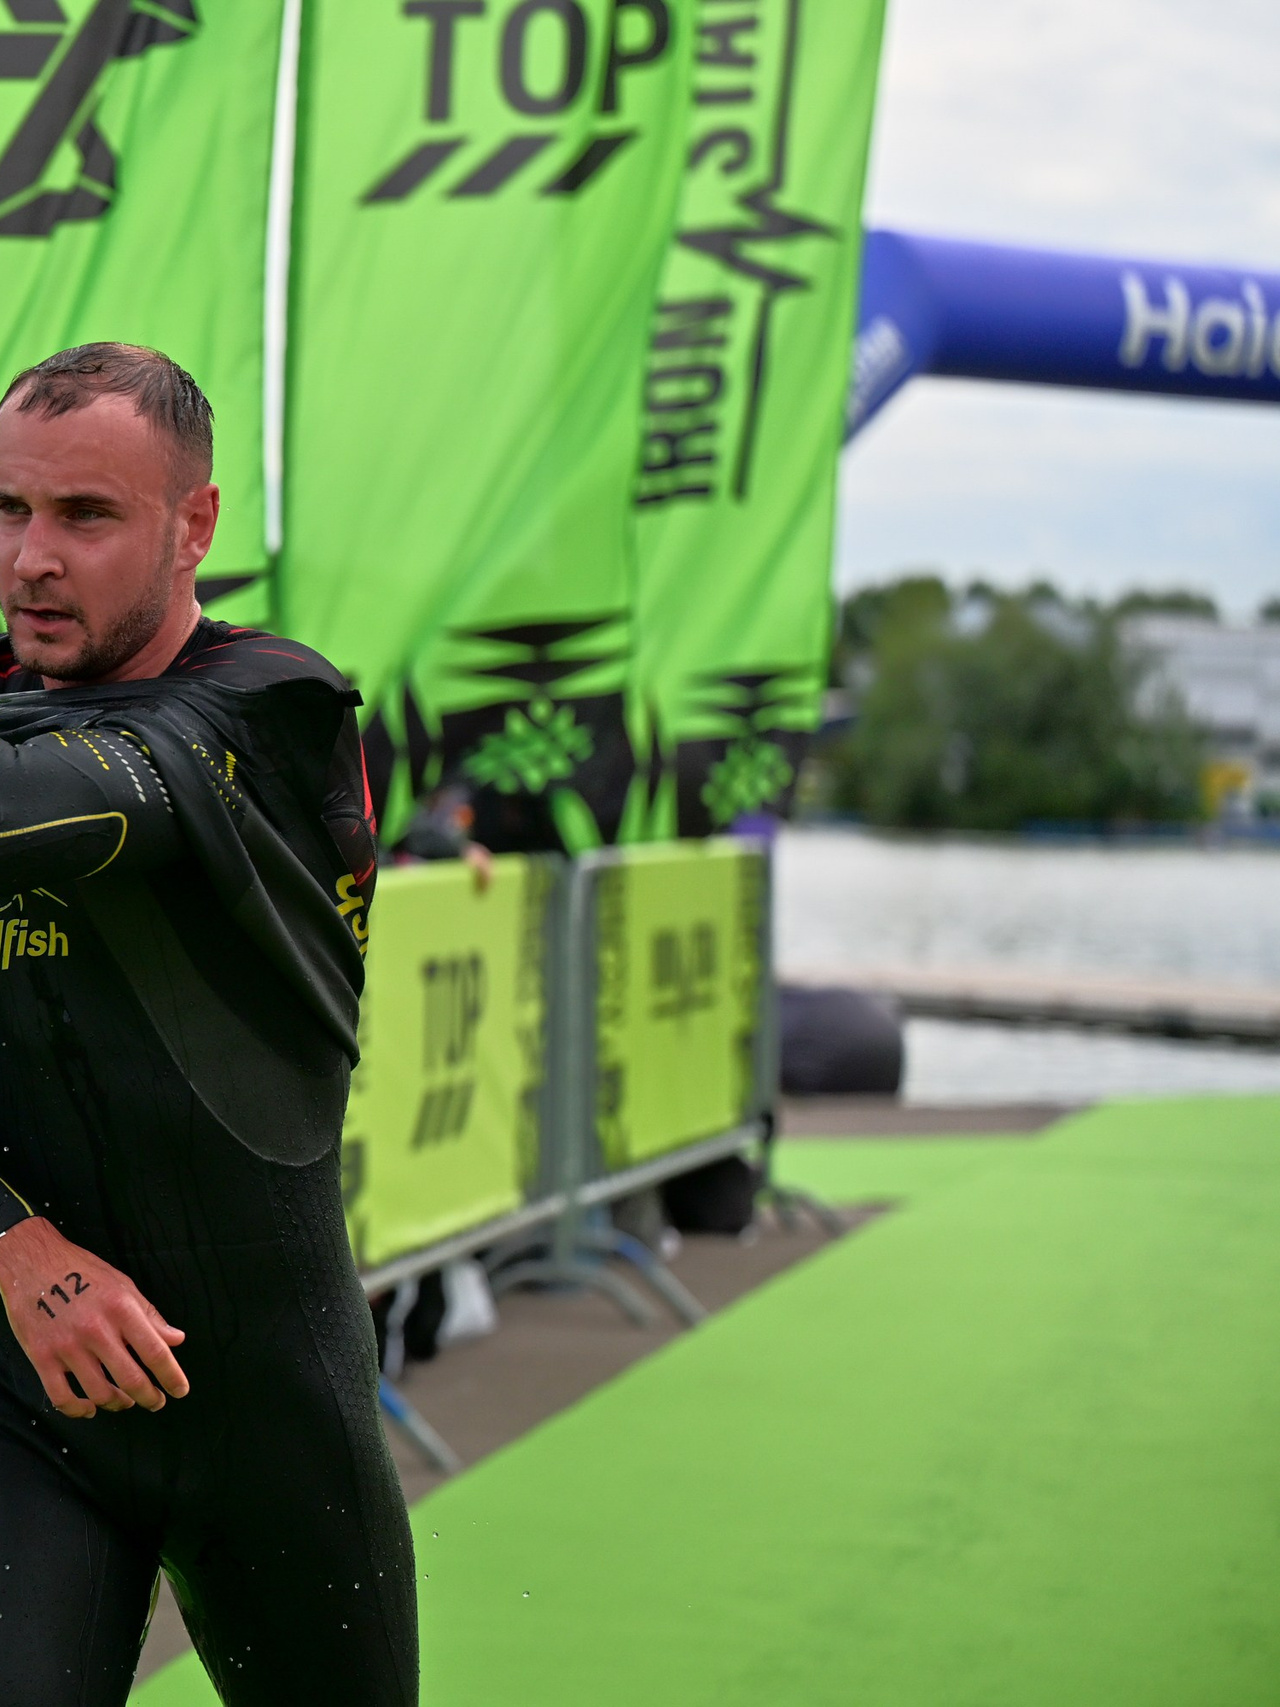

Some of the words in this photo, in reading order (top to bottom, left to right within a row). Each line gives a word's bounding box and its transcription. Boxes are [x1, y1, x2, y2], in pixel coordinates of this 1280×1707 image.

[401, 0, 674, 124] TOP
[1120, 268, 1280, 380] Hai
[36, 1272, 91, 1319] 112
